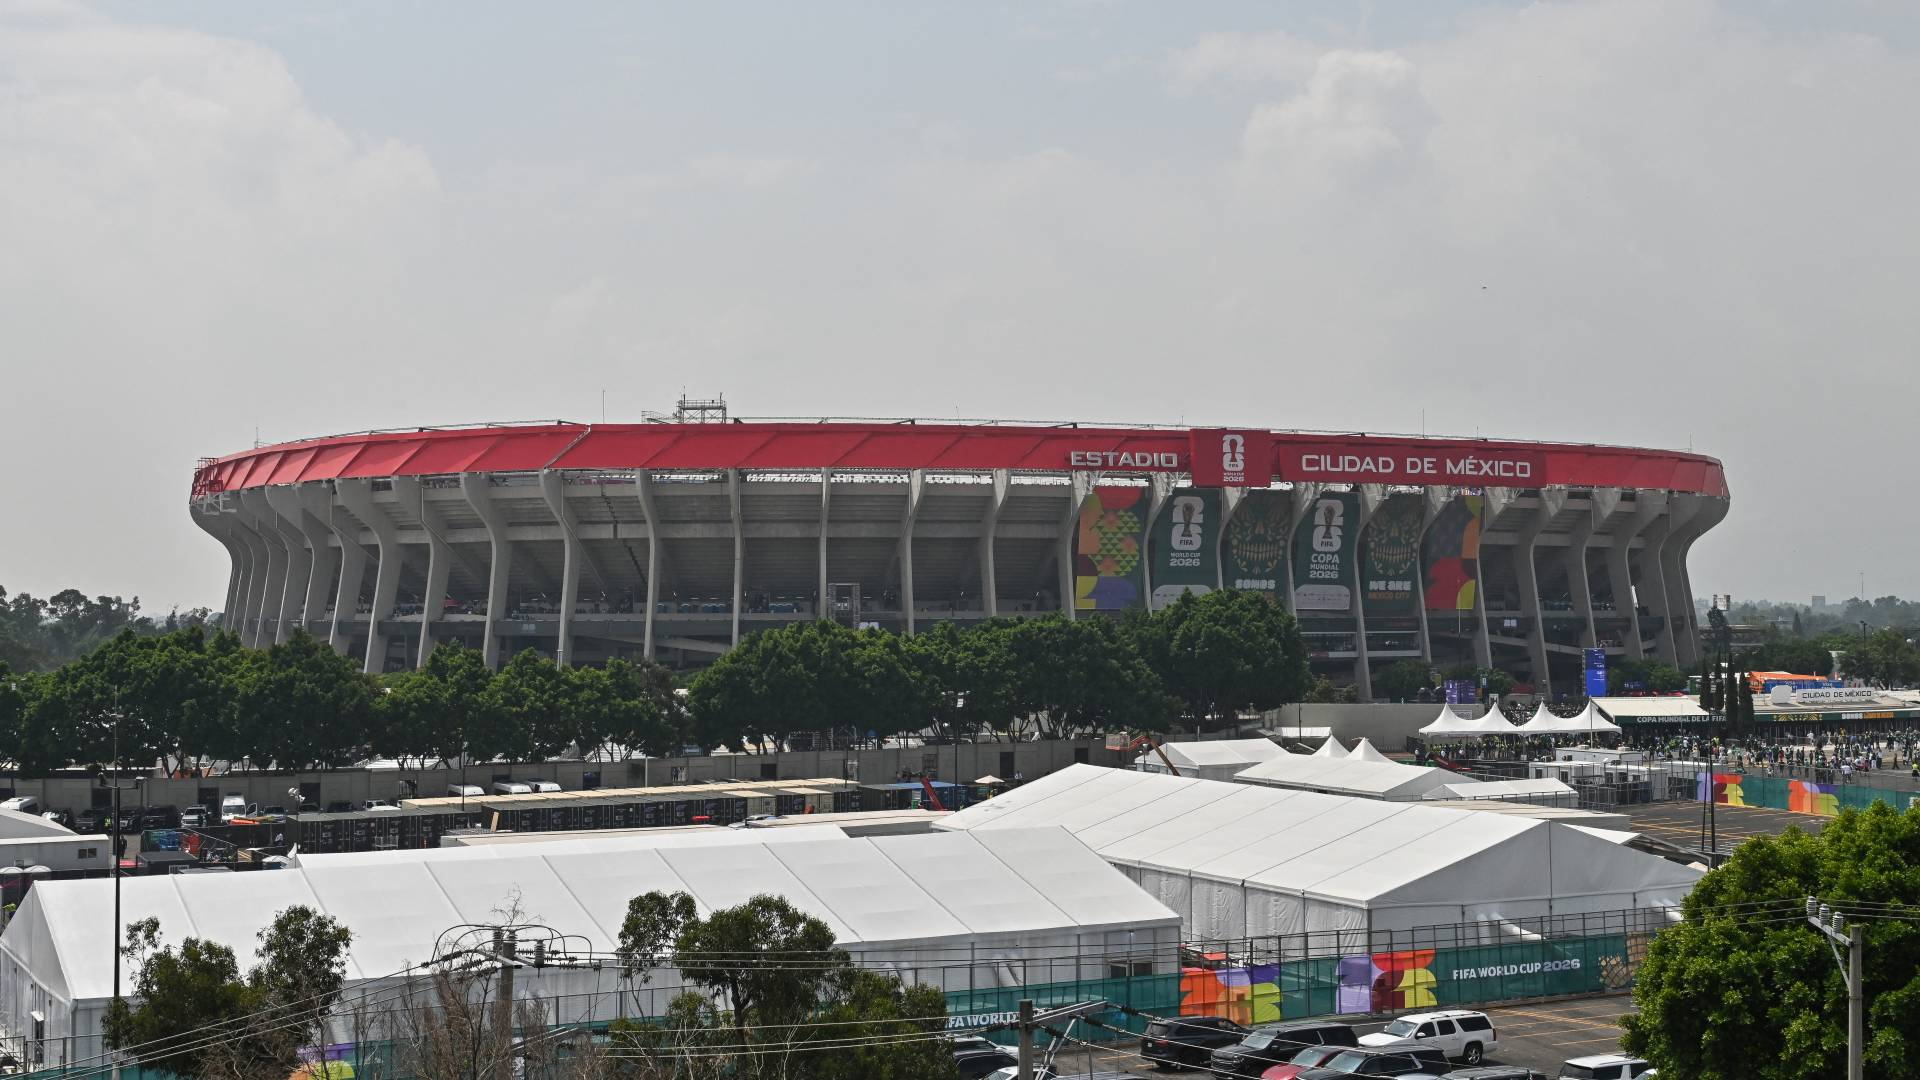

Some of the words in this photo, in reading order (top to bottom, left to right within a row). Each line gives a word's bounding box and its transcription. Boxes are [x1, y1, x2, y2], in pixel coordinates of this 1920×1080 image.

[1071, 451, 1178, 468] ESTADIO
[1302, 454, 1395, 473] CIUDAD
[1406, 457, 1437, 474] DE
[1446, 456, 1531, 477] MÉXICO
[1169, 558, 1200, 566] 2026
[1311, 553, 1340, 563] COPA
[1309, 570, 1339, 578] 2026
[1453, 969, 1477, 980] FIFA
[1478, 965, 1518, 979] WORLD
[1520, 962, 1541, 974] CUP
[1543, 959, 1580, 972] 2026
[967, 1012, 1017, 1026] WORLD
